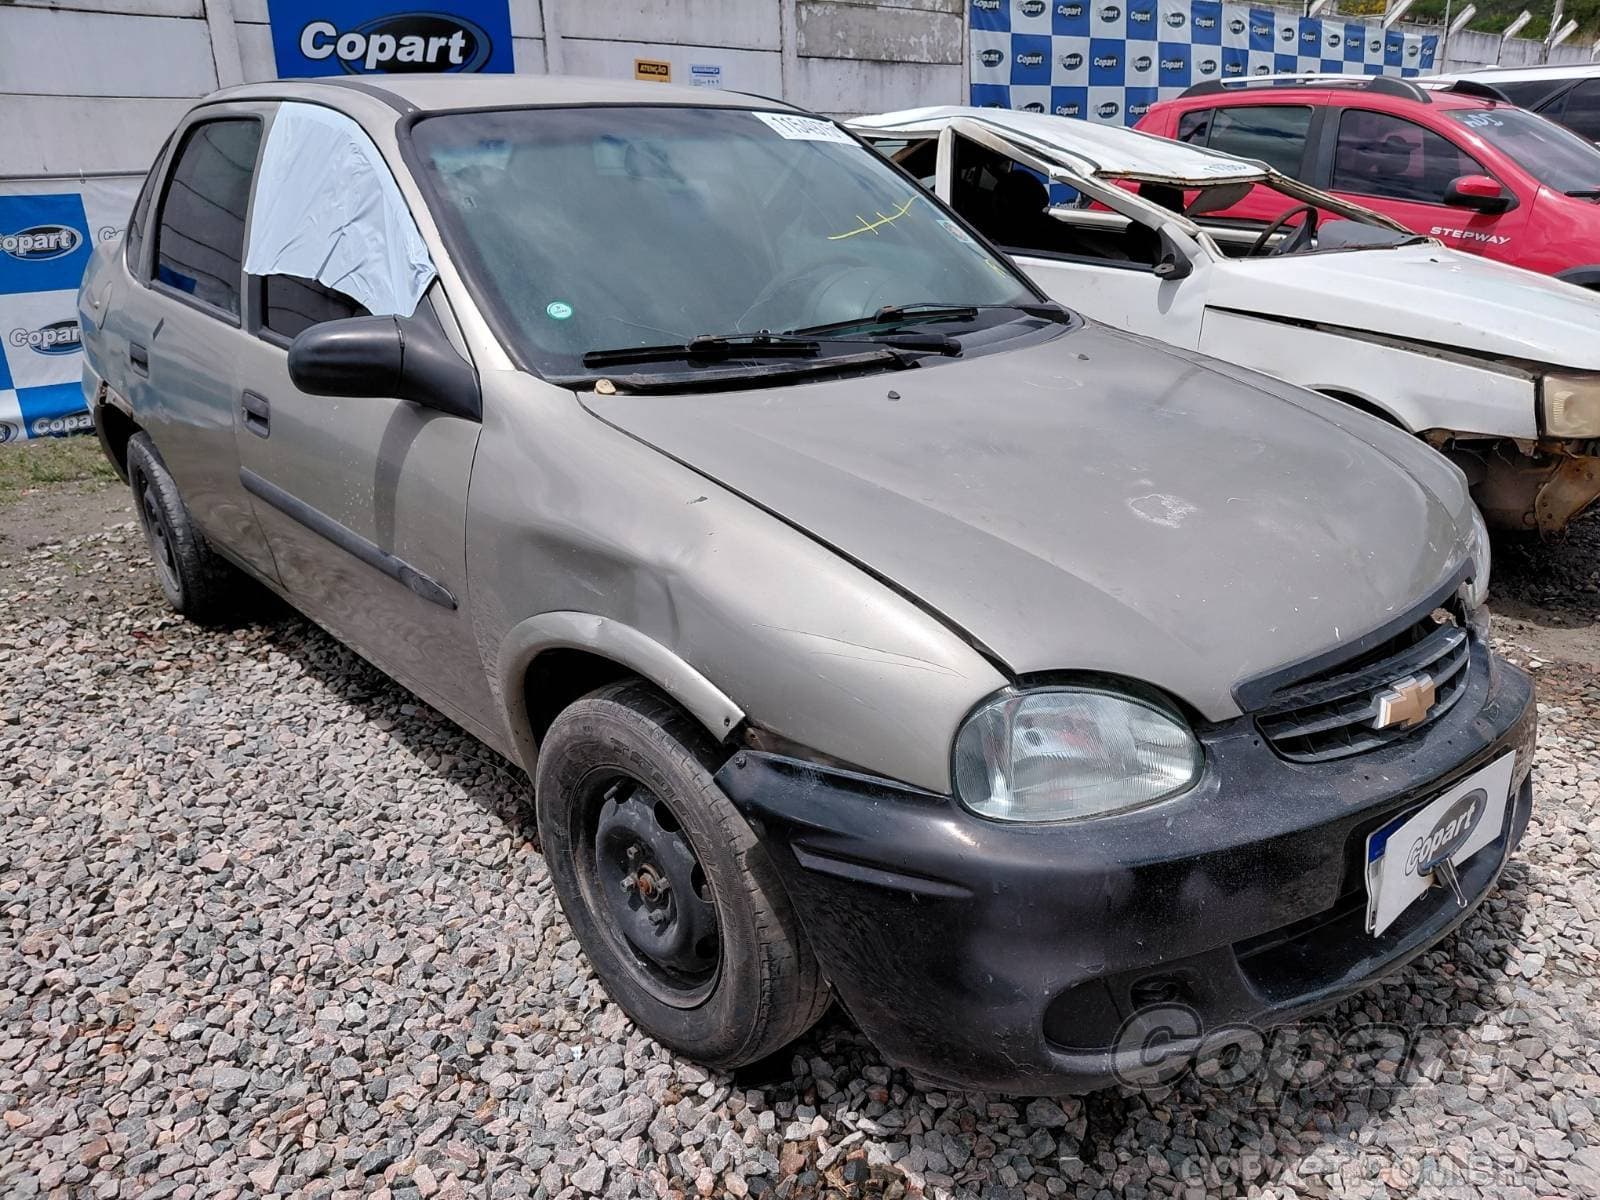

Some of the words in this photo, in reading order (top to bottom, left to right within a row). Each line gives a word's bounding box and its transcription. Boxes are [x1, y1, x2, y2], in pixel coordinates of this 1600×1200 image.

[1057, 5, 1082, 16] Copart
[300, 21, 466, 70] Copart
[1017, 54, 1043, 66] Copart
[1093, 57, 1117, 68] Copart
[1160, 60, 1184, 70] Copart
[1055, 105, 1080, 117] Copart
[0, 229, 71, 256] opart
[1430, 226, 1511, 245] STEPWAY
[9, 327, 80, 349] Copar
[31, 414, 95, 435] Copa
[1405, 800, 1478, 876] Copart
